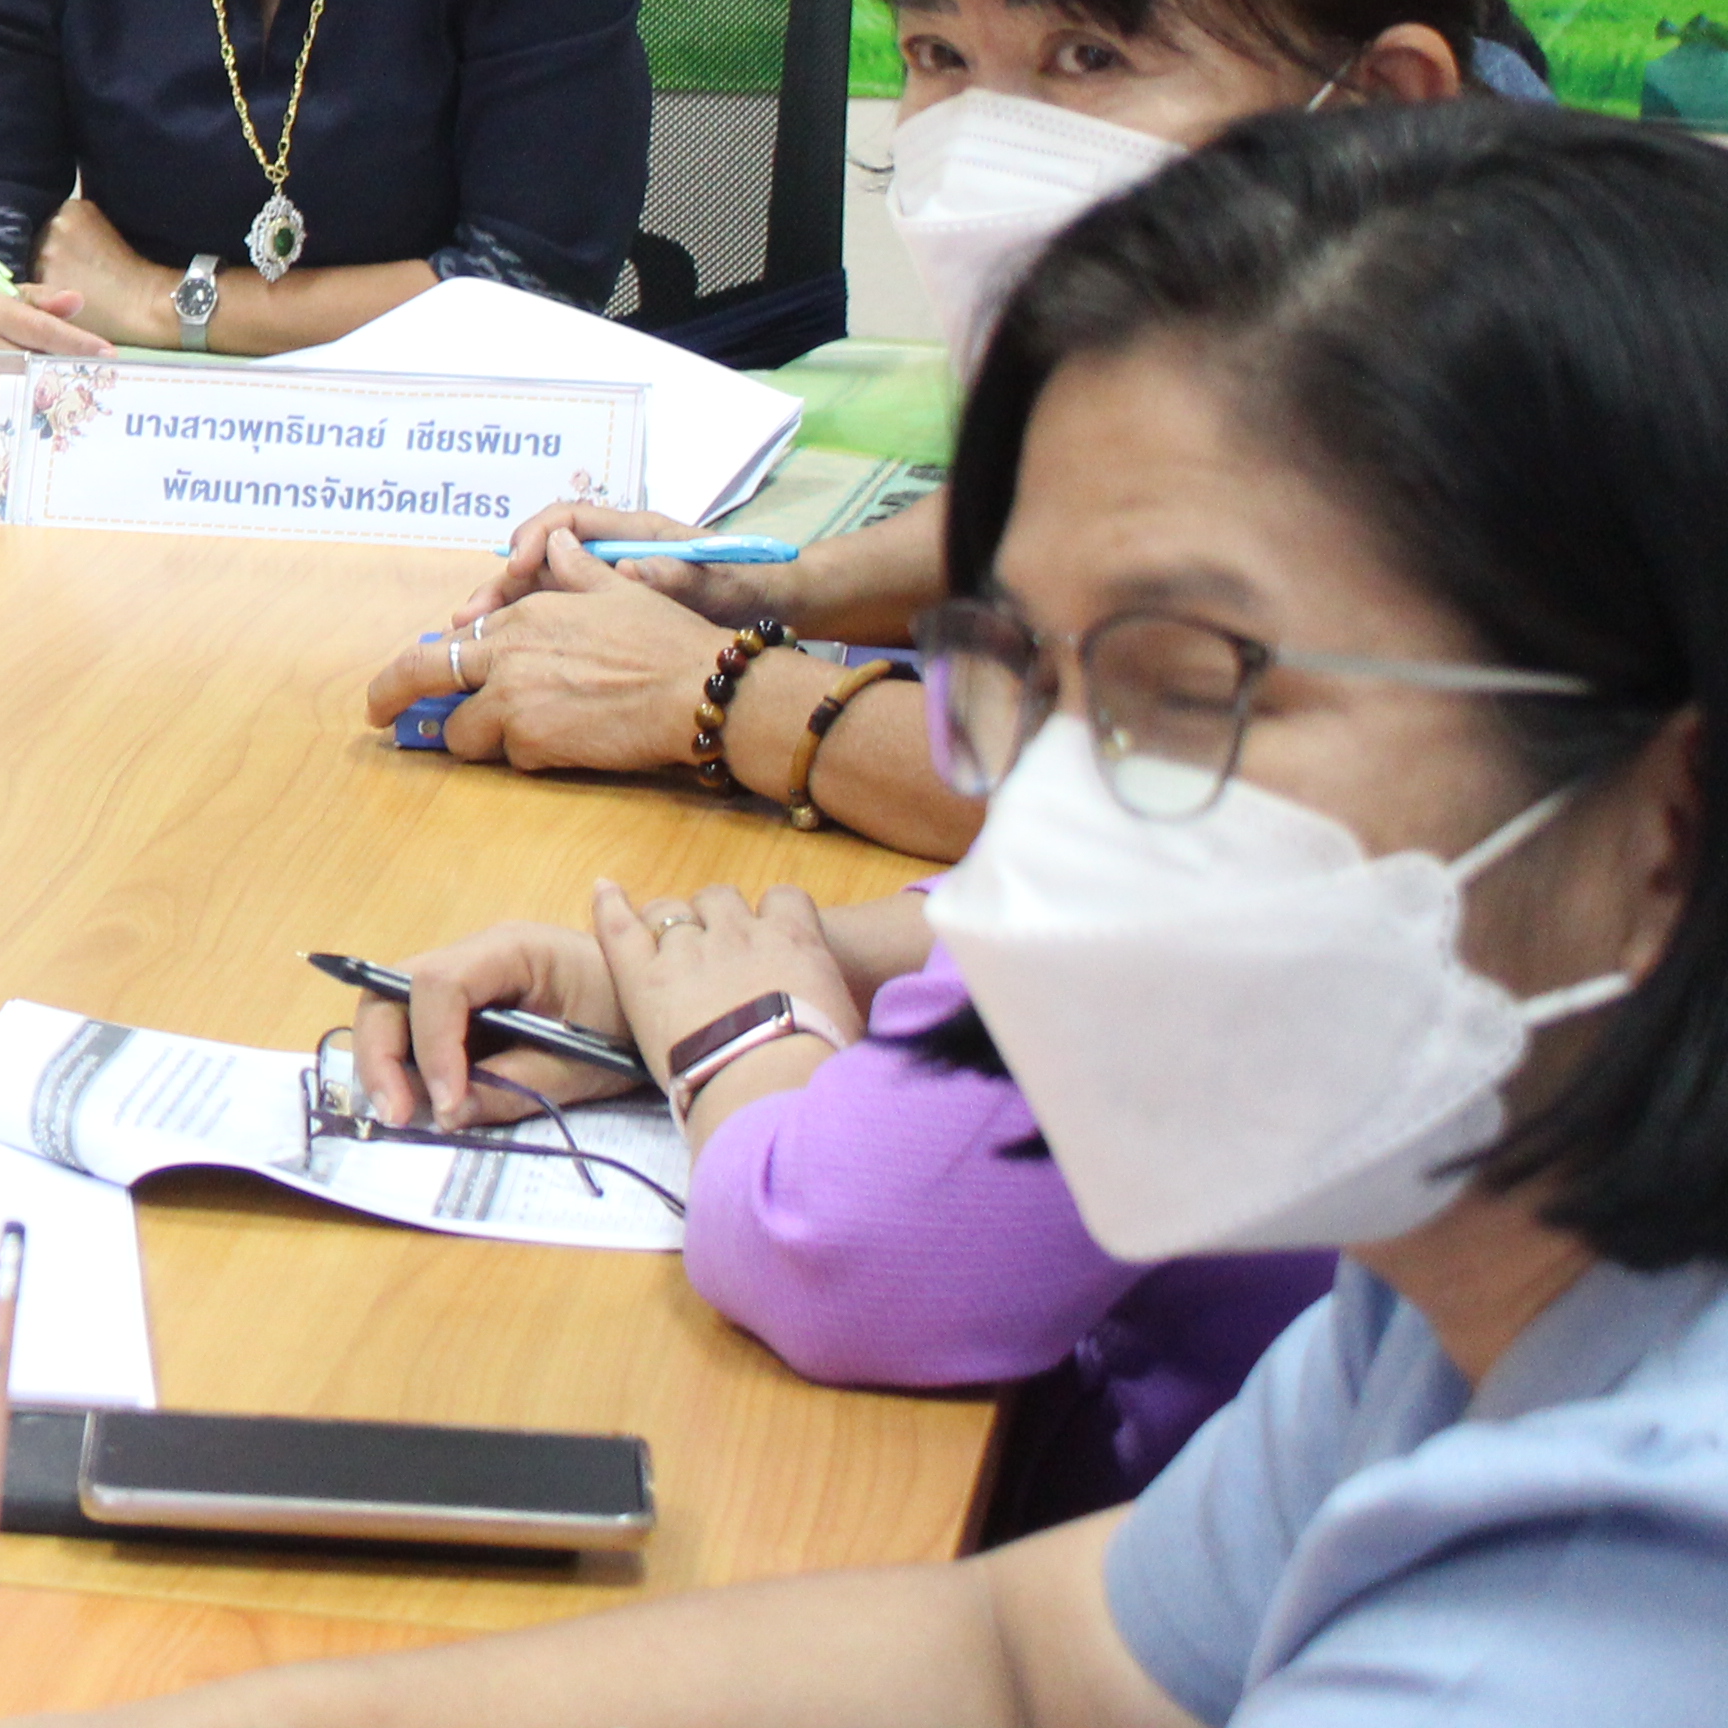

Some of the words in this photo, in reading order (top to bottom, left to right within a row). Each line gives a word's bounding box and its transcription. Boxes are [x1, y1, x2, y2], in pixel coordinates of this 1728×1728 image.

[125, 412, 386, 453] นางสาวพุทธิมาลย์
[162, 468, 511, 520] พัฒนาการจังหวัดยโสธร
